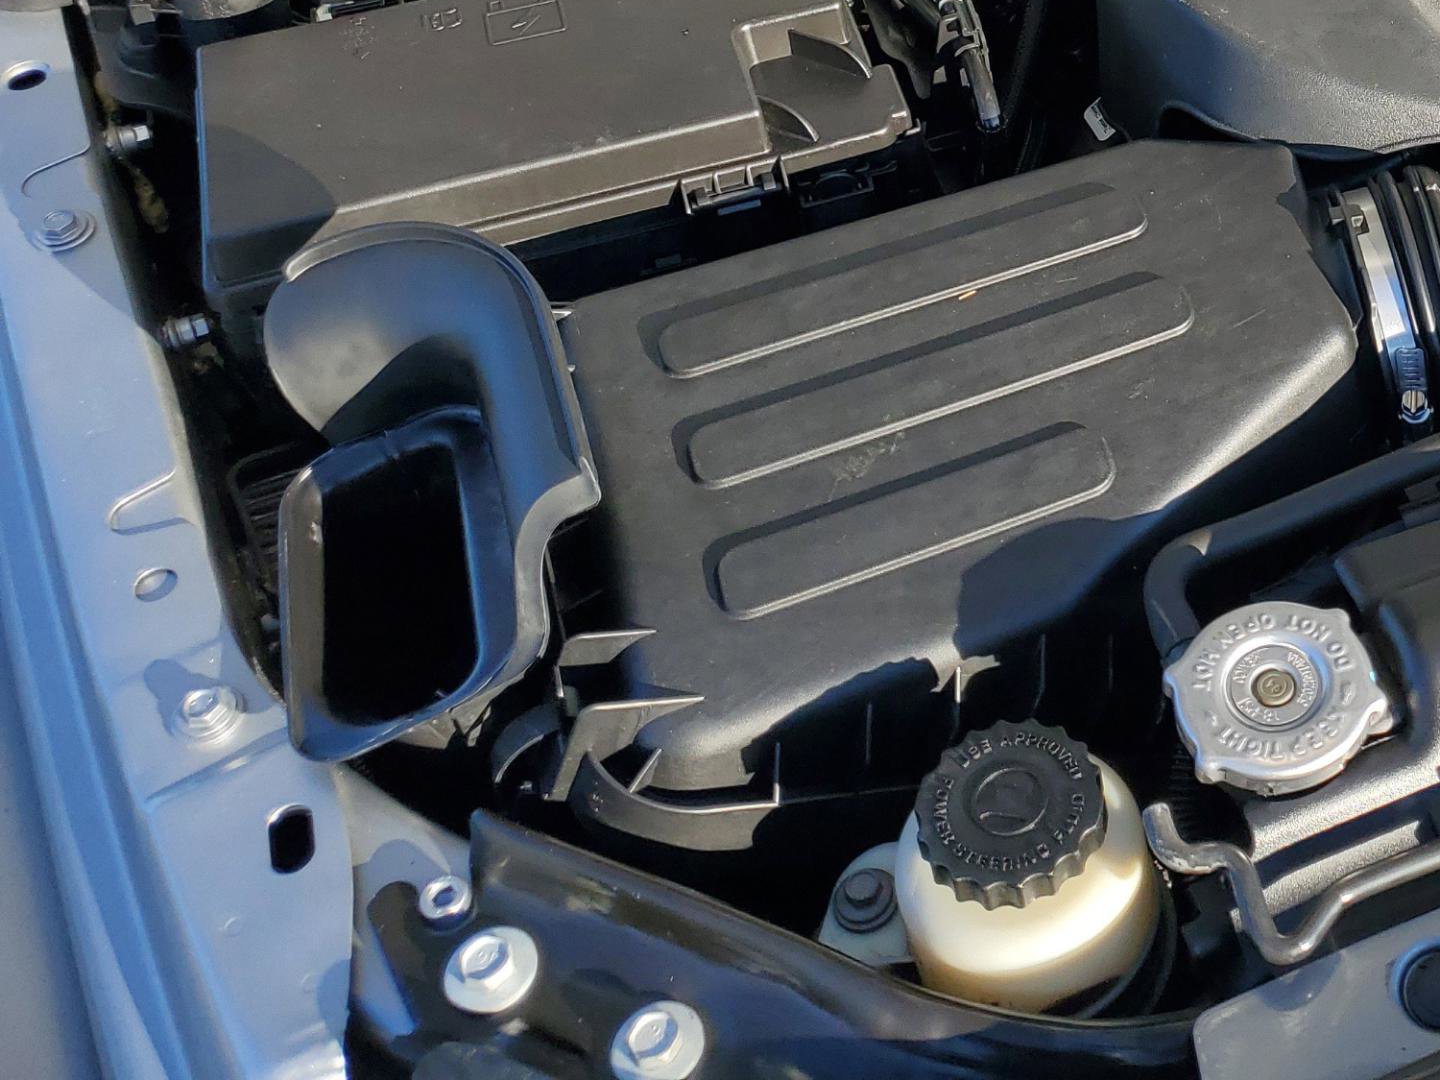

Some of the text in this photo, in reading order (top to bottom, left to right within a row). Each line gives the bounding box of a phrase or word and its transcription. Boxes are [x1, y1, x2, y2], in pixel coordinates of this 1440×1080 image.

[1220, 613, 1275, 649] OPEN
[1286, 615, 1332, 642] NOT
[1193, 649, 1221, 691] HOT
[1326, 642, 1353, 672] DO
[954, 731, 1082, 780] USE APPROVED
[1218, 728, 1285, 760] TIGHT
[934, 776, 1085, 871] POWER STEERING FLUID
